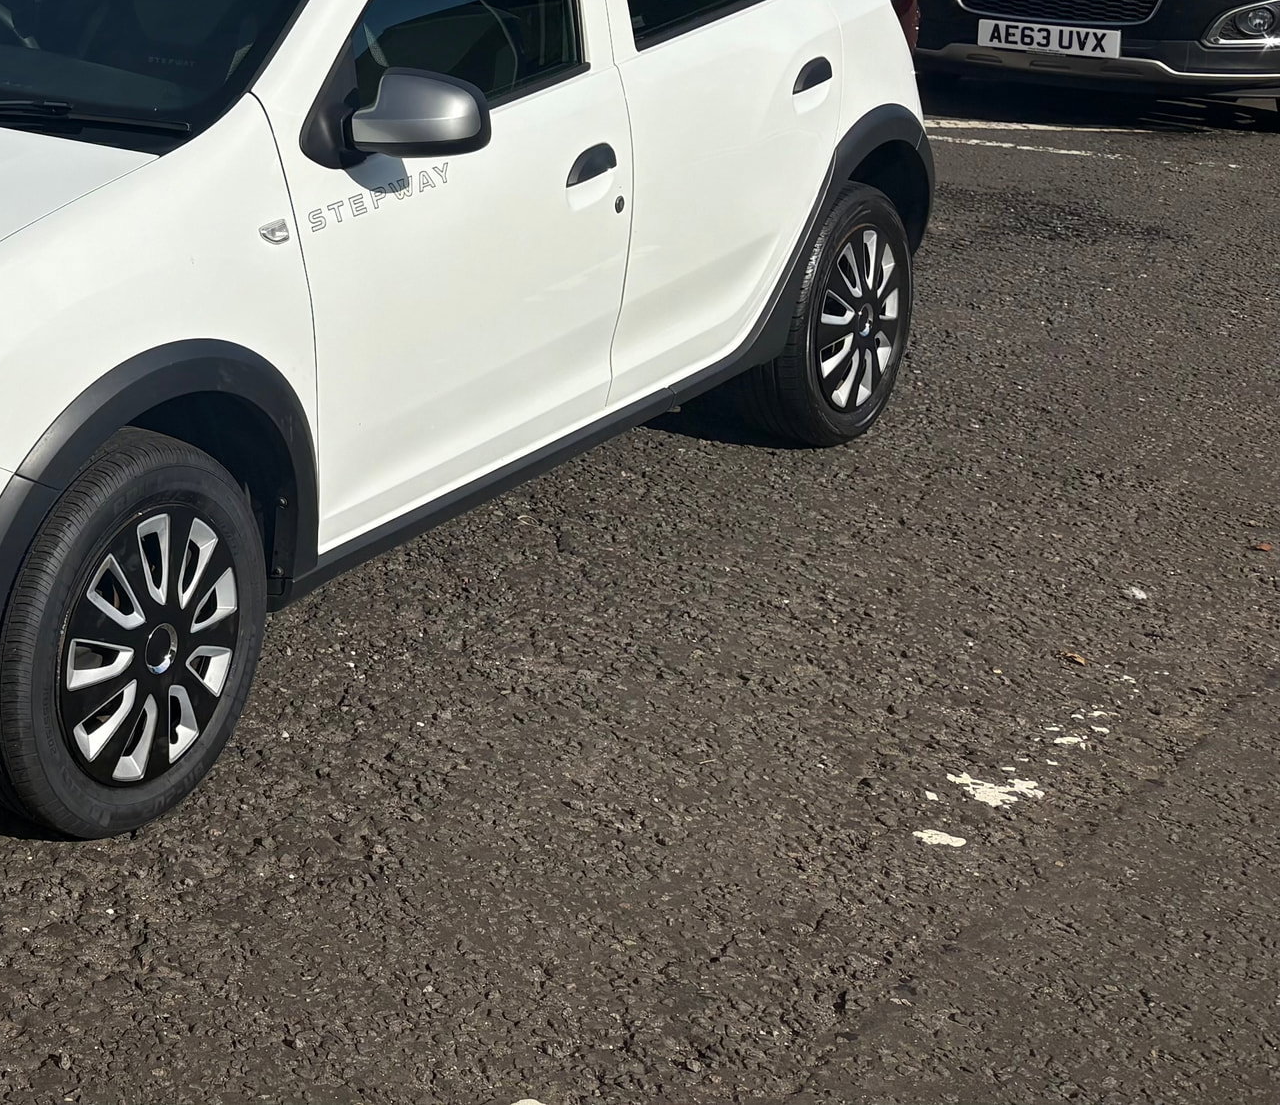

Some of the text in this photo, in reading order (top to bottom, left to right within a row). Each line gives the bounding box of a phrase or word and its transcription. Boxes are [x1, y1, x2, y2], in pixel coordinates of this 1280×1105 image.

[989, 23, 1051, 48] AE63
[1058, 29, 1107, 53] UVX
[308, 162, 449, 232] STEPWAY
